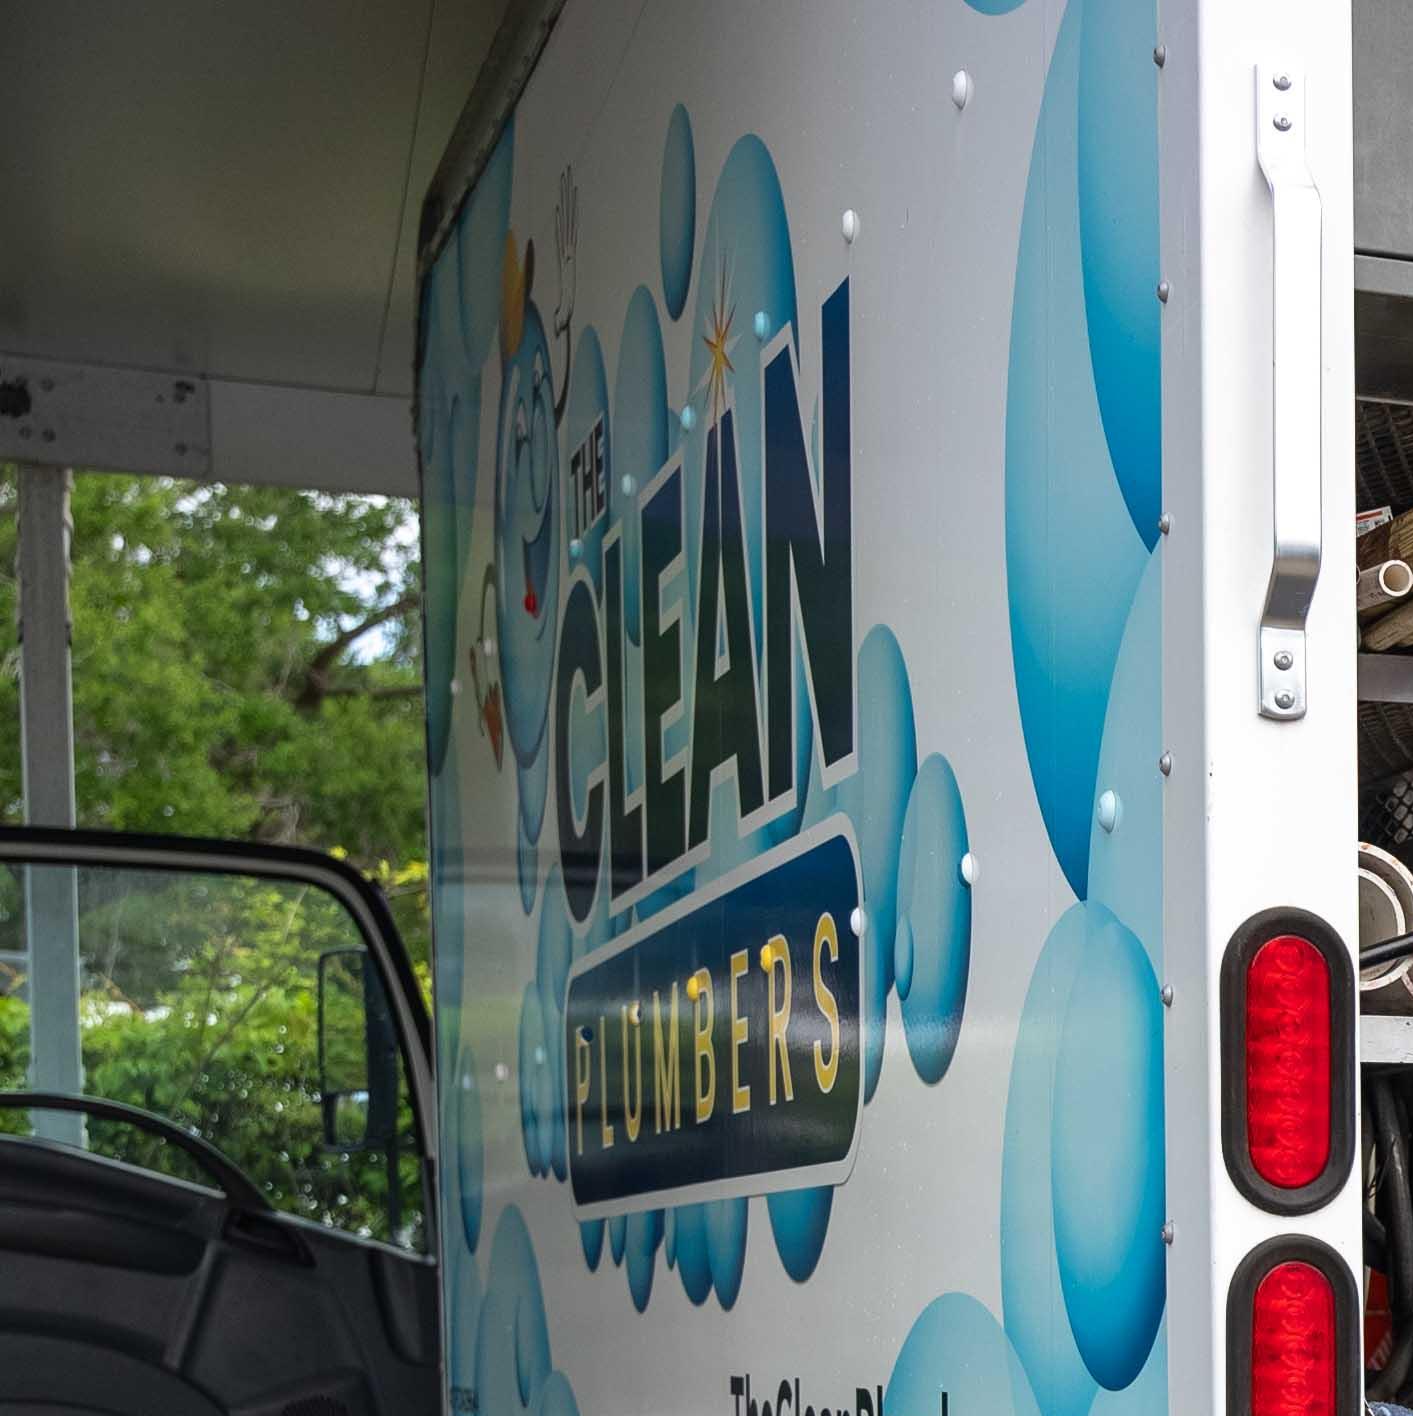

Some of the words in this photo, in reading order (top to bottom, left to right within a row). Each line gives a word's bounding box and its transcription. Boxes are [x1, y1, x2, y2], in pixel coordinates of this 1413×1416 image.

[555, 275, 856, 924] CLEAN
[570, 418, 605, 538] THE
[575, 911, 840, 1156] PLUMBERS
